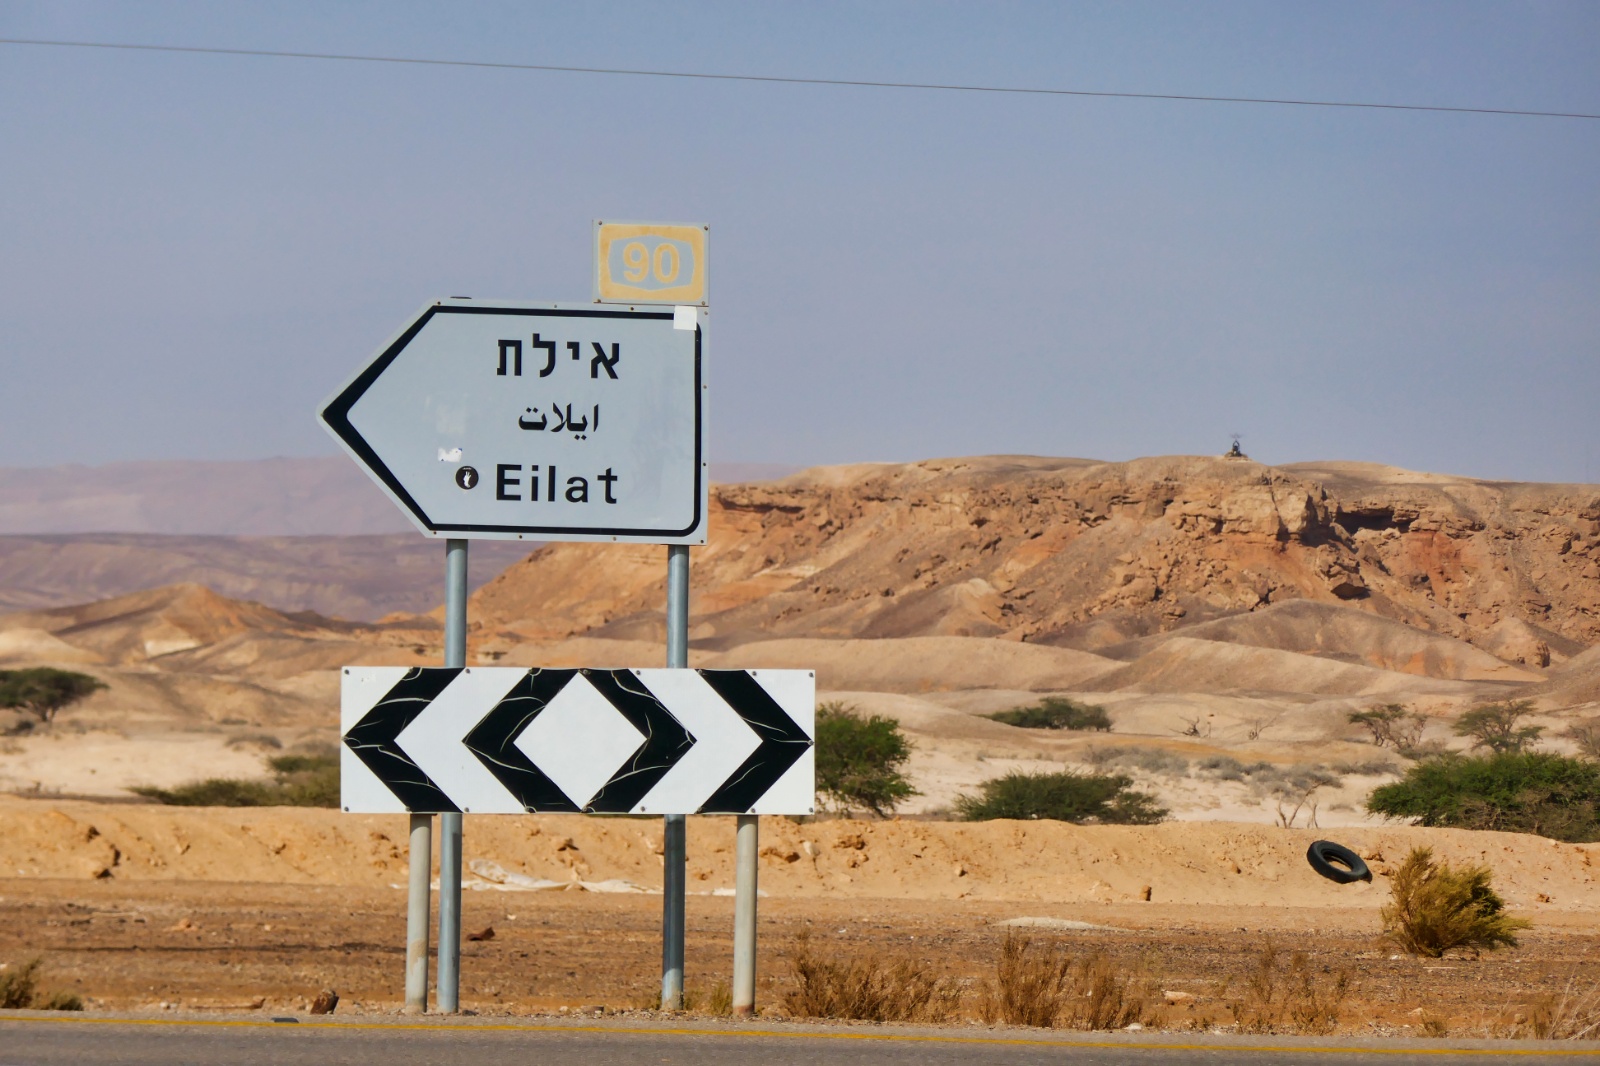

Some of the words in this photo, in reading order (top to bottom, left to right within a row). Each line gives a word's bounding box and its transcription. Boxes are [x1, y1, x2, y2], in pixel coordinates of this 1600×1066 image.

[623, 242, 679, 284] 90
[496, 332, 620, 380] אילת
[518, 402, 599, 441] ايلات
[496, 463, 618, 505] Eilat
